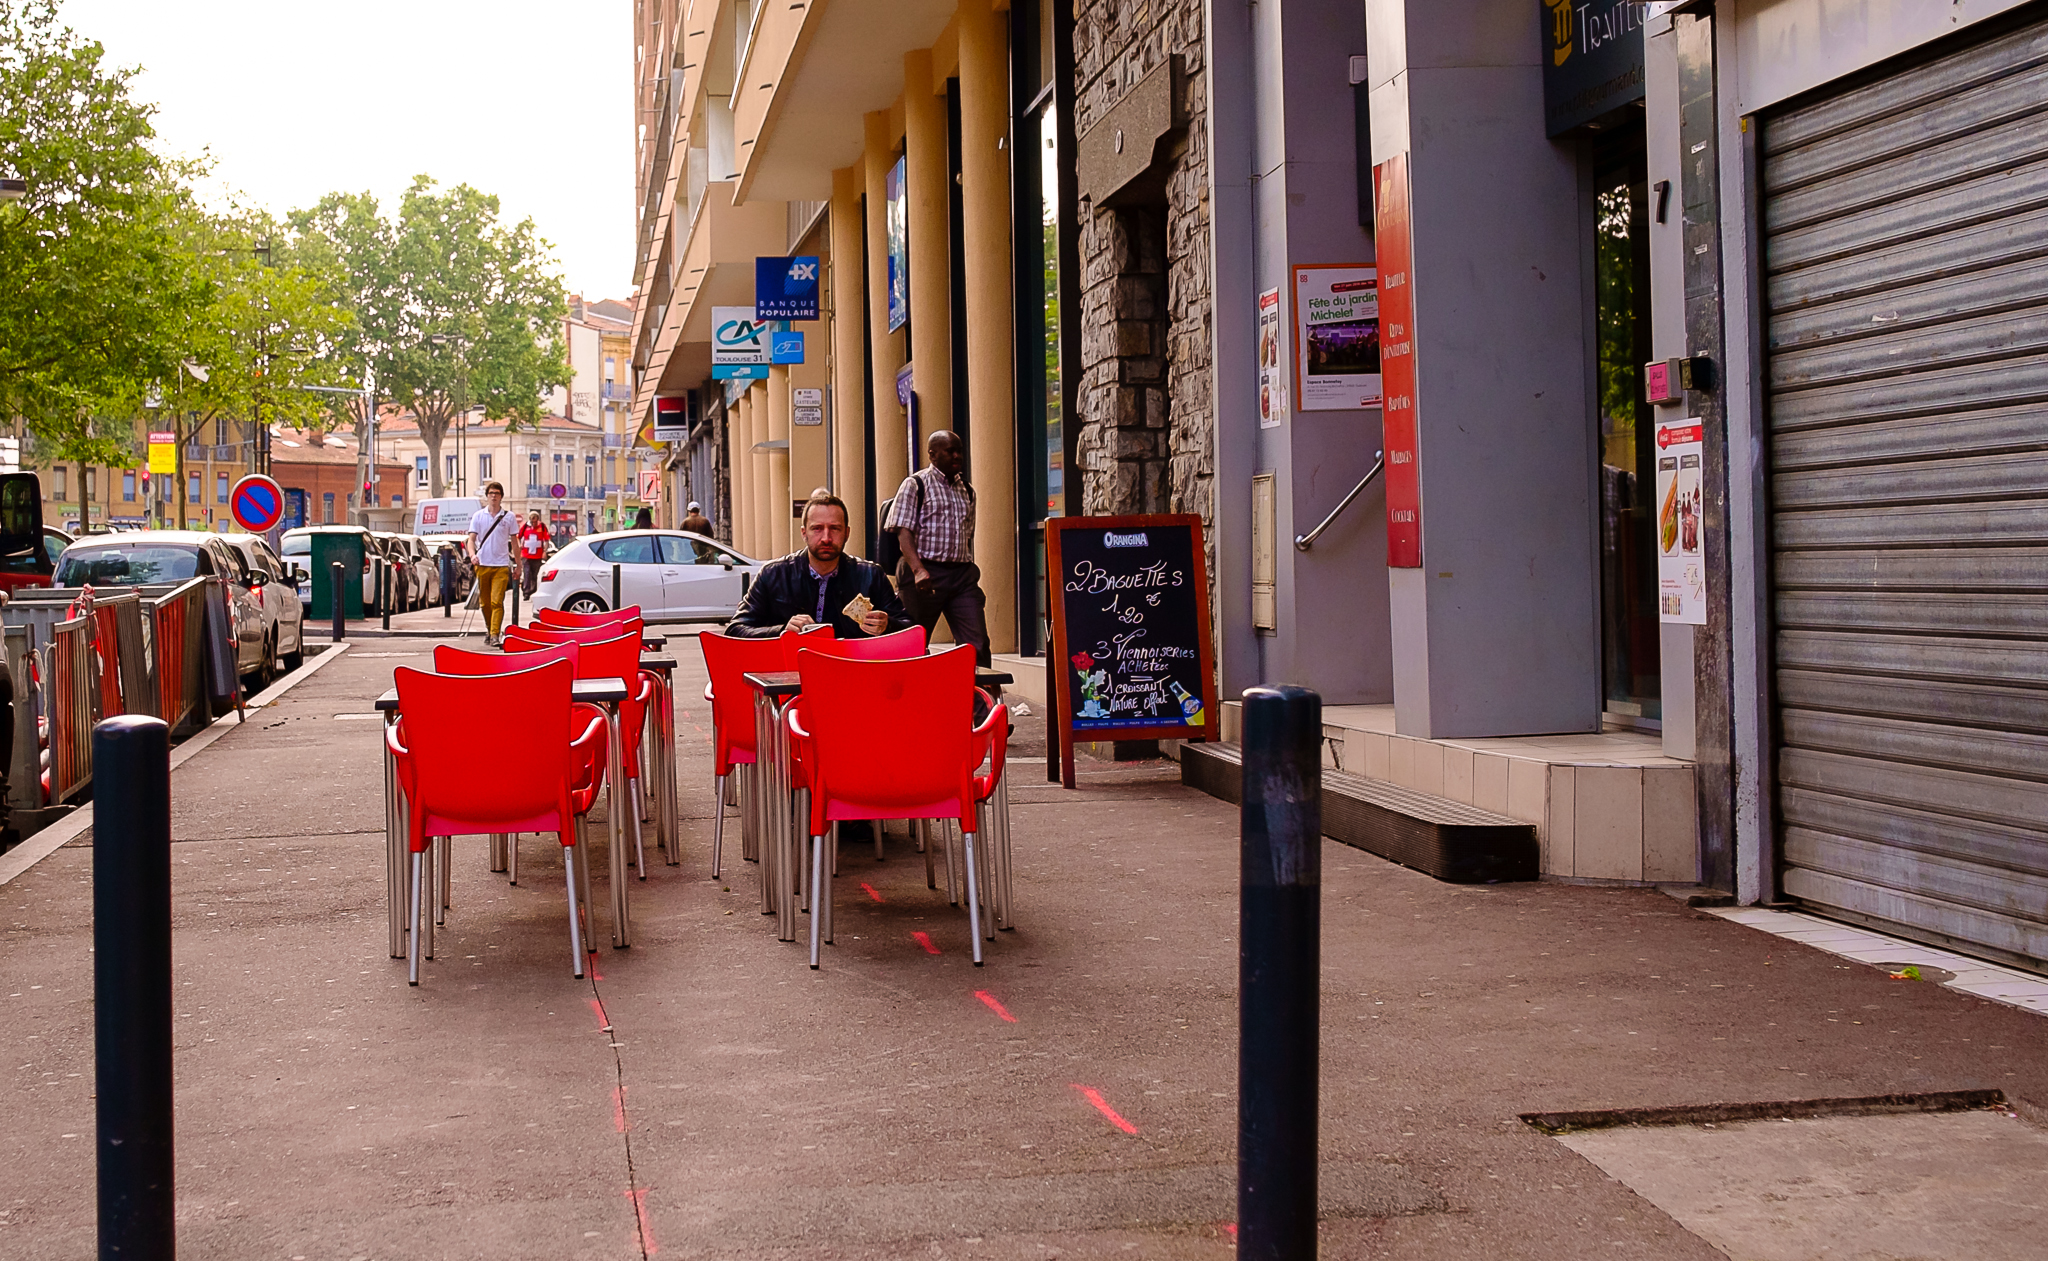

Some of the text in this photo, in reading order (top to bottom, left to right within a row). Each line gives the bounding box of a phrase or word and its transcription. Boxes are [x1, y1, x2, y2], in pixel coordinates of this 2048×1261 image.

[1653, 179, 1670, 225] 7
[1308, 292, 1377, 309] Fête du jardin
[1310, 308, 1354, 321] Michelet
[1104, 532, 1148, 548] ORANGINA
[1066, 560, 1092, 592] 2
[1101, 594, 1144, 623] 1.20
[1092, 641, 1112, 659] 3
[1103, 673, 1113, 694] 1
